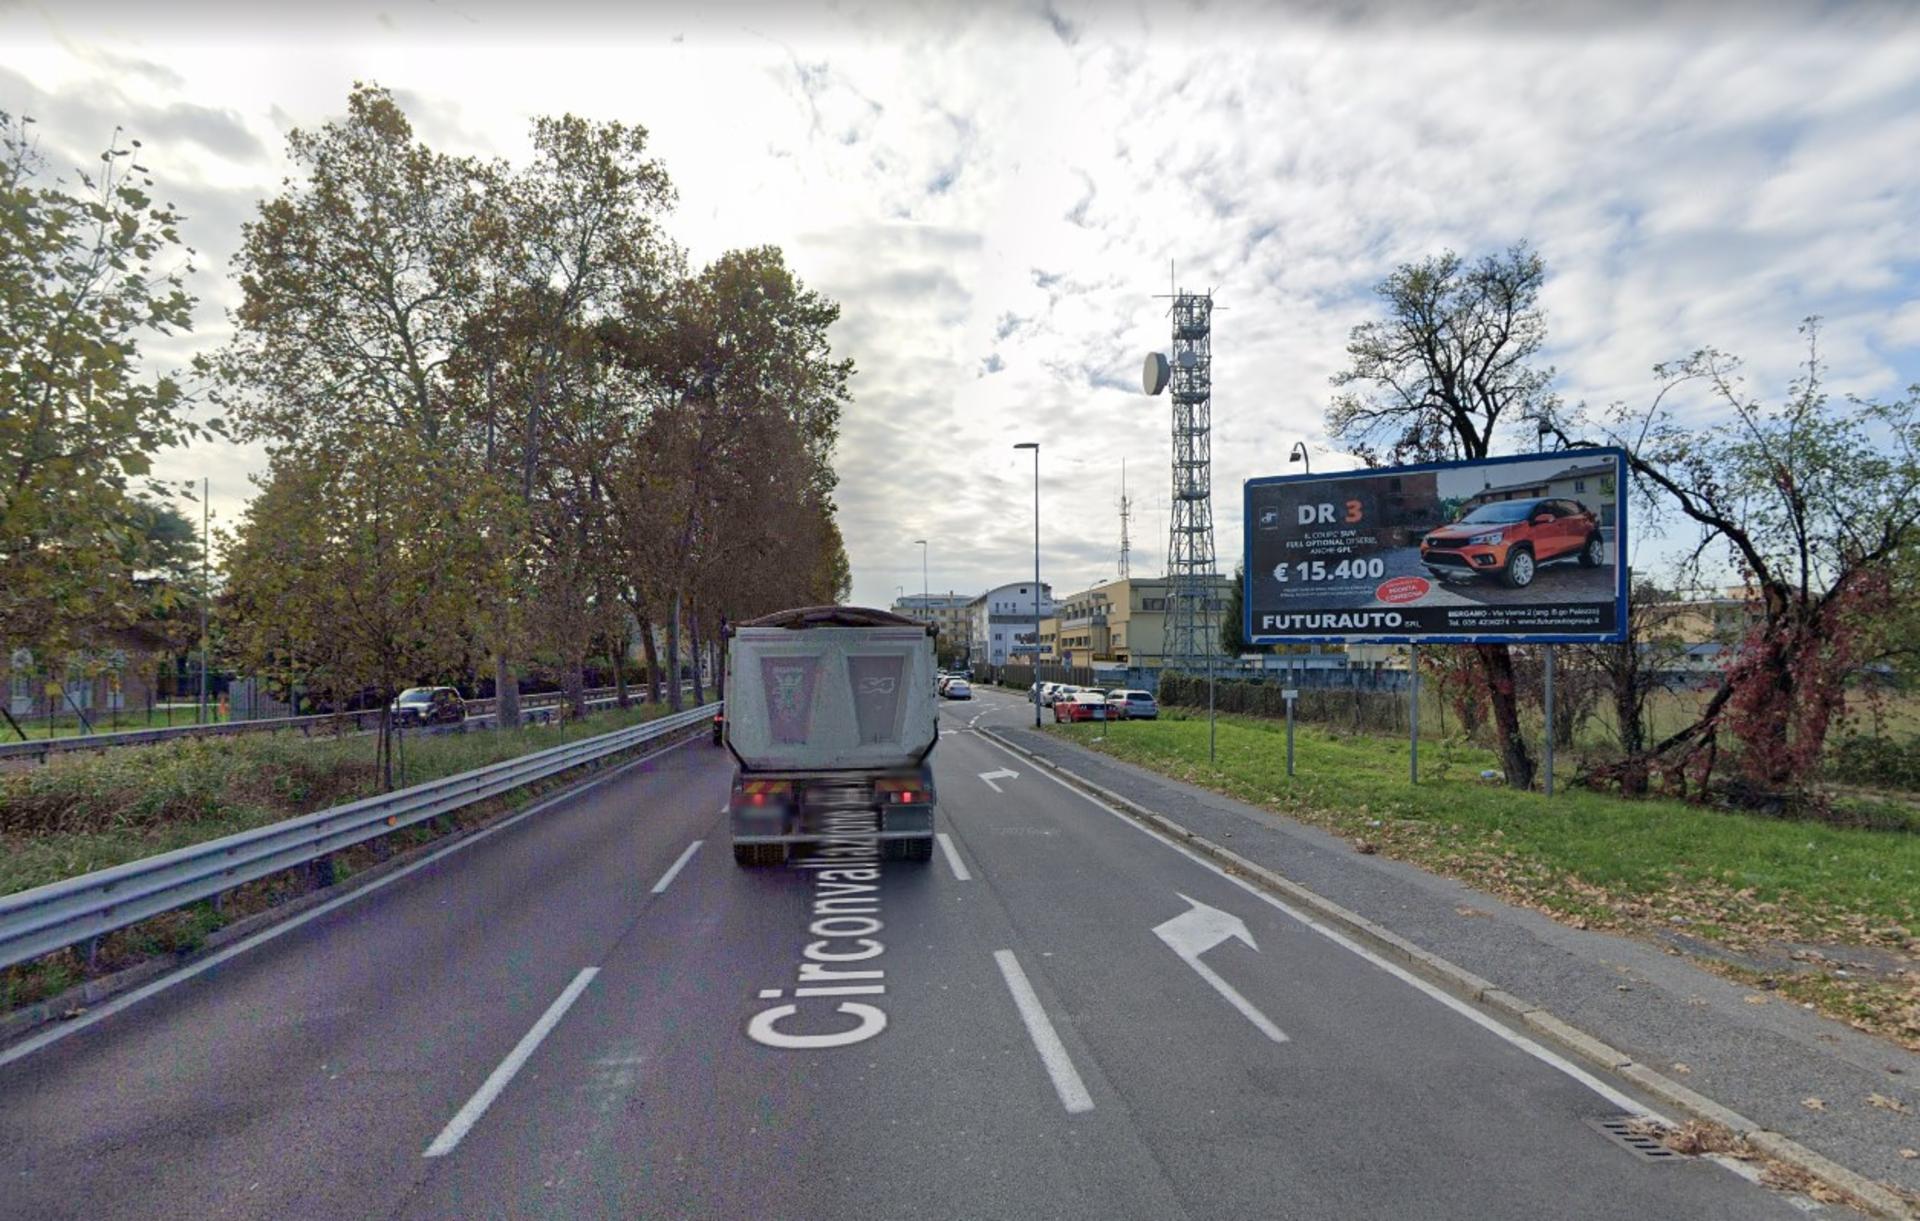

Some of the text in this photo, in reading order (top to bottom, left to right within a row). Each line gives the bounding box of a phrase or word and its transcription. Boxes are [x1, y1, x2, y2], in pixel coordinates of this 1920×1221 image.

[1298, 499, 1363, 525] DR 3
[1306, 538, 1345, 547] OPTIONAL
[1273, 558, 1384, 582] € 15.400
[1262, 612, 1402, 629] FUTURAUTO
[1448, 610, 1487, 618] BERGAMO
